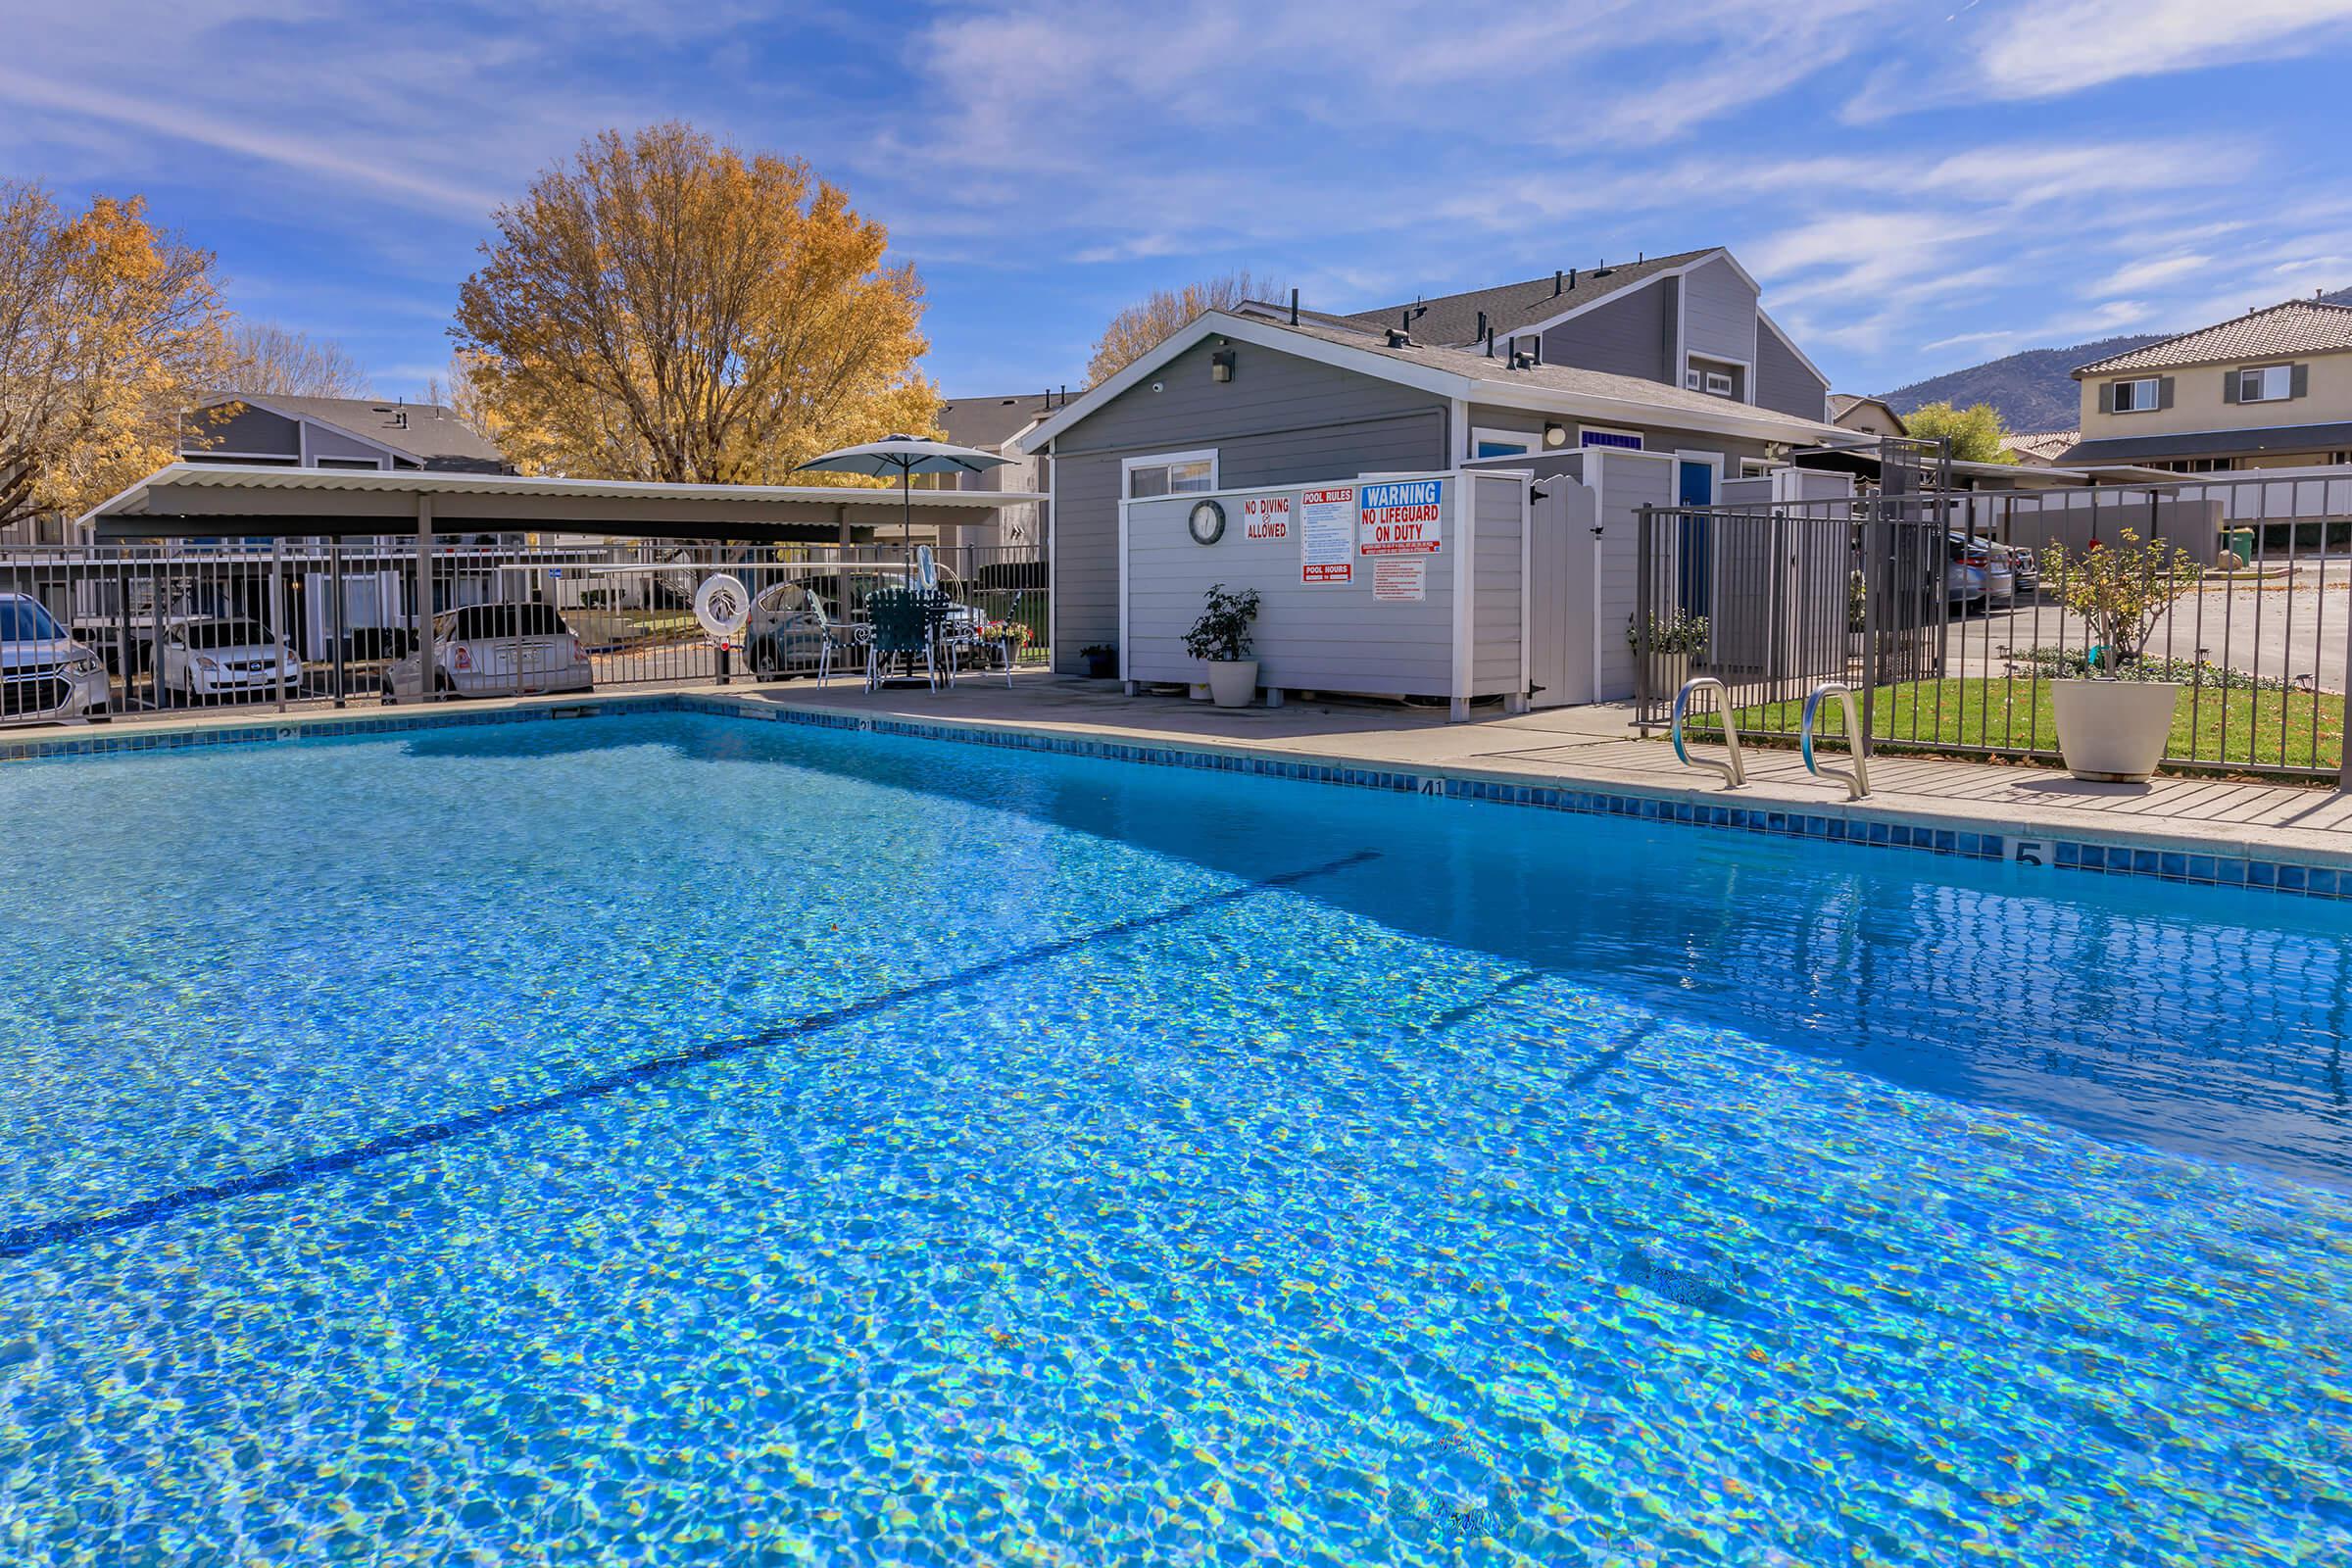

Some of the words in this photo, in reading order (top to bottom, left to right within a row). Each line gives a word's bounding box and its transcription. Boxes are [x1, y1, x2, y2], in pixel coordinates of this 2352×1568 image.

[1304, 492, 1324, 503] POOL
[1326, 490, 1350, 502] RULES
[1367, 483, 1436, 507] WARNING
[1245, 500, 1256, 514] NO
[1260, 498, 1289, 514] DIVING
[1362, 508, 1376, 524] NO
[1380, 505, 1439, 523] LIFEGUARD
[1248, 522, 1286, 538] ALLOWED
[1376, 525, 1390, 542] ON
[1395, 523, 1423, 541] DUTY
[1325, 564, 1348, 573] HOURS
[2016, 842, 2042, 866] 5
